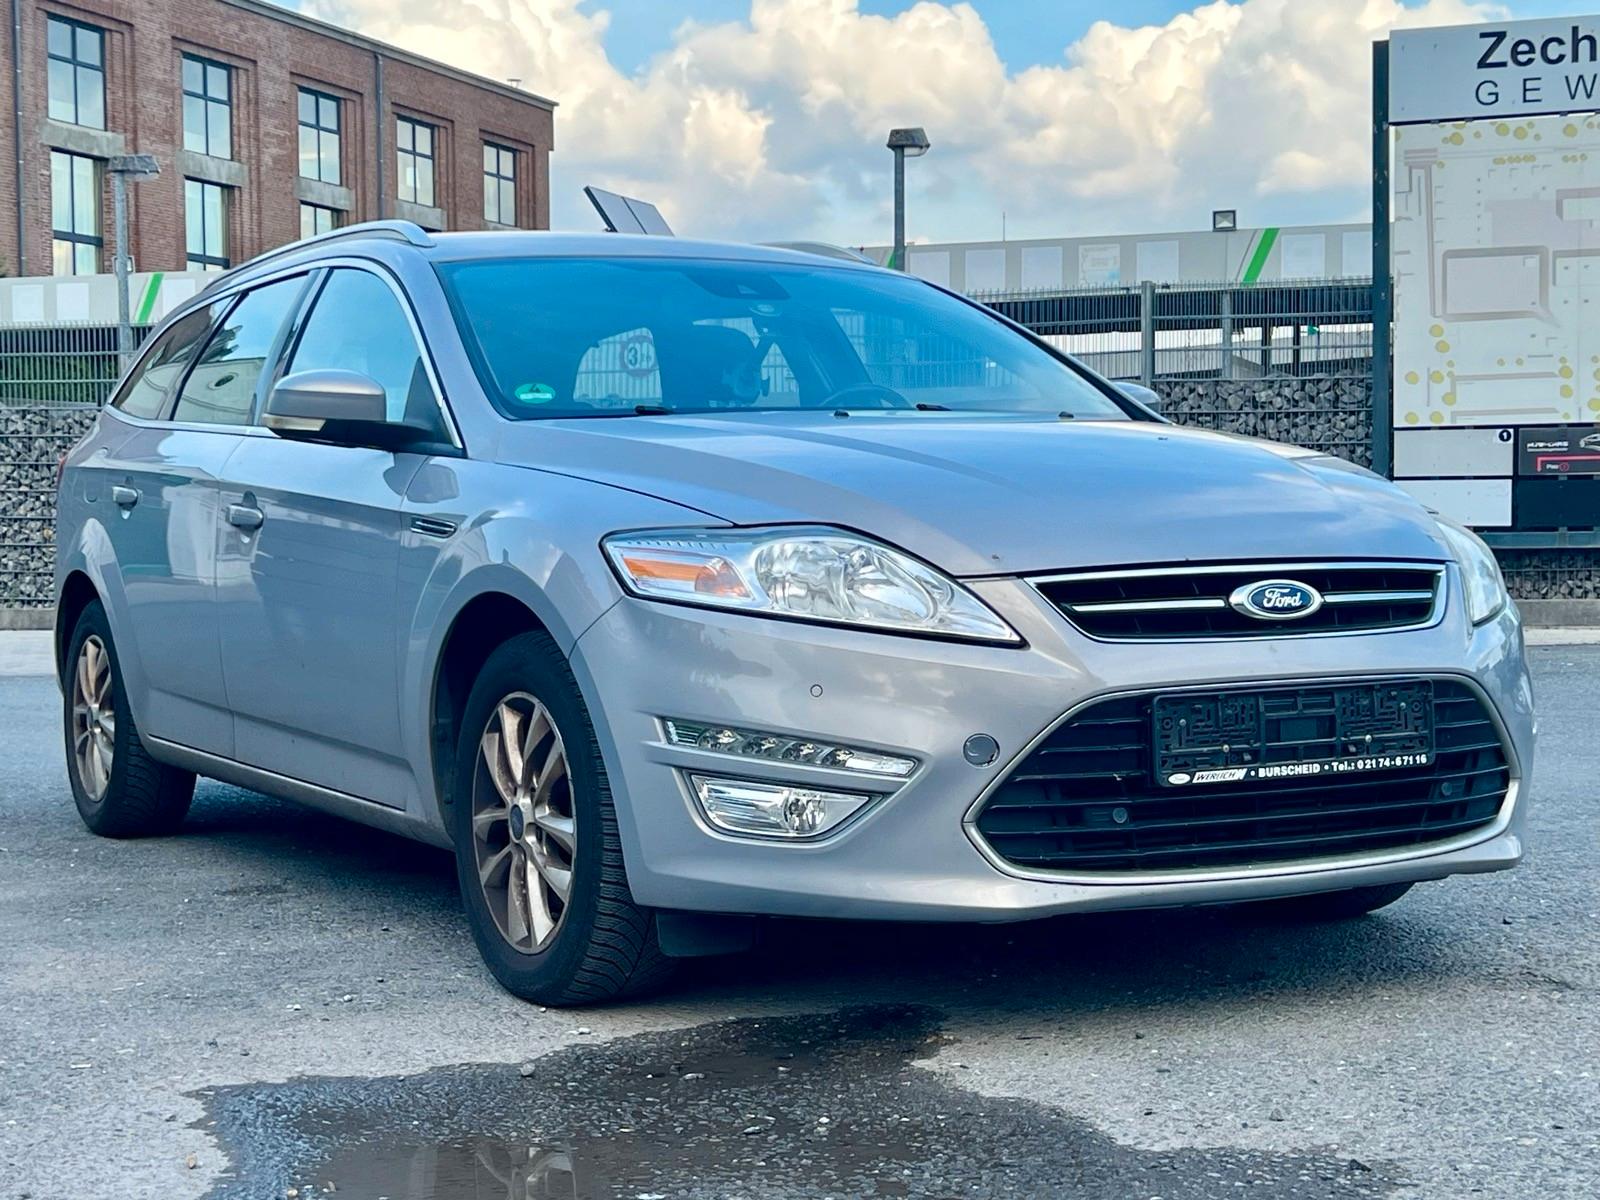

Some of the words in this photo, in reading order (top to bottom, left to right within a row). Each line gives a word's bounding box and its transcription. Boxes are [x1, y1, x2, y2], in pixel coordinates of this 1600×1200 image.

[1476, 25, 1598, 69] Zech
[1263, 588, 1303, 608] Ford
[1258, 763, 1320, 777] BURSCHEID
